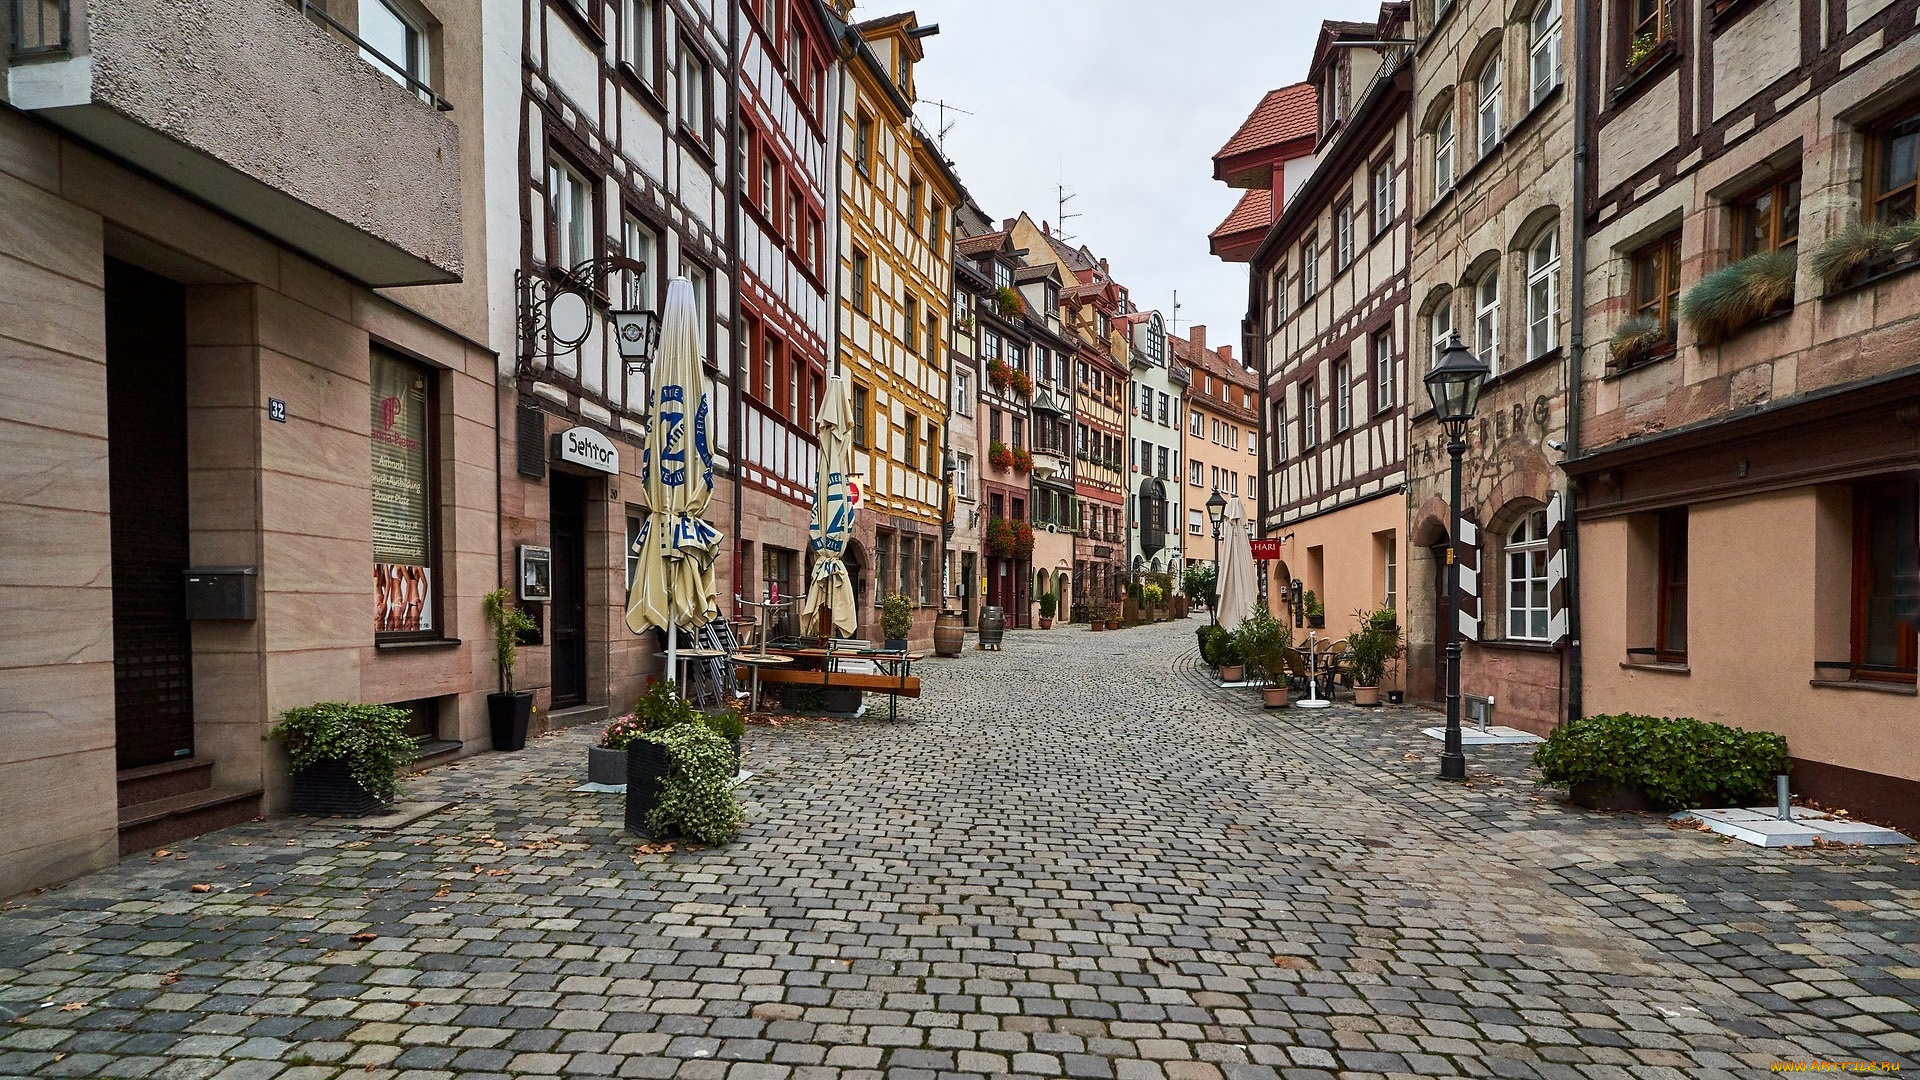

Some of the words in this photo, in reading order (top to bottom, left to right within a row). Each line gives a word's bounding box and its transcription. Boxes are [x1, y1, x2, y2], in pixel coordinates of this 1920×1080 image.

[272, 401, 285, 419] 32
[569, 432, 614, 464] Sektor
[1254, 543, 1276, 551] HARI
